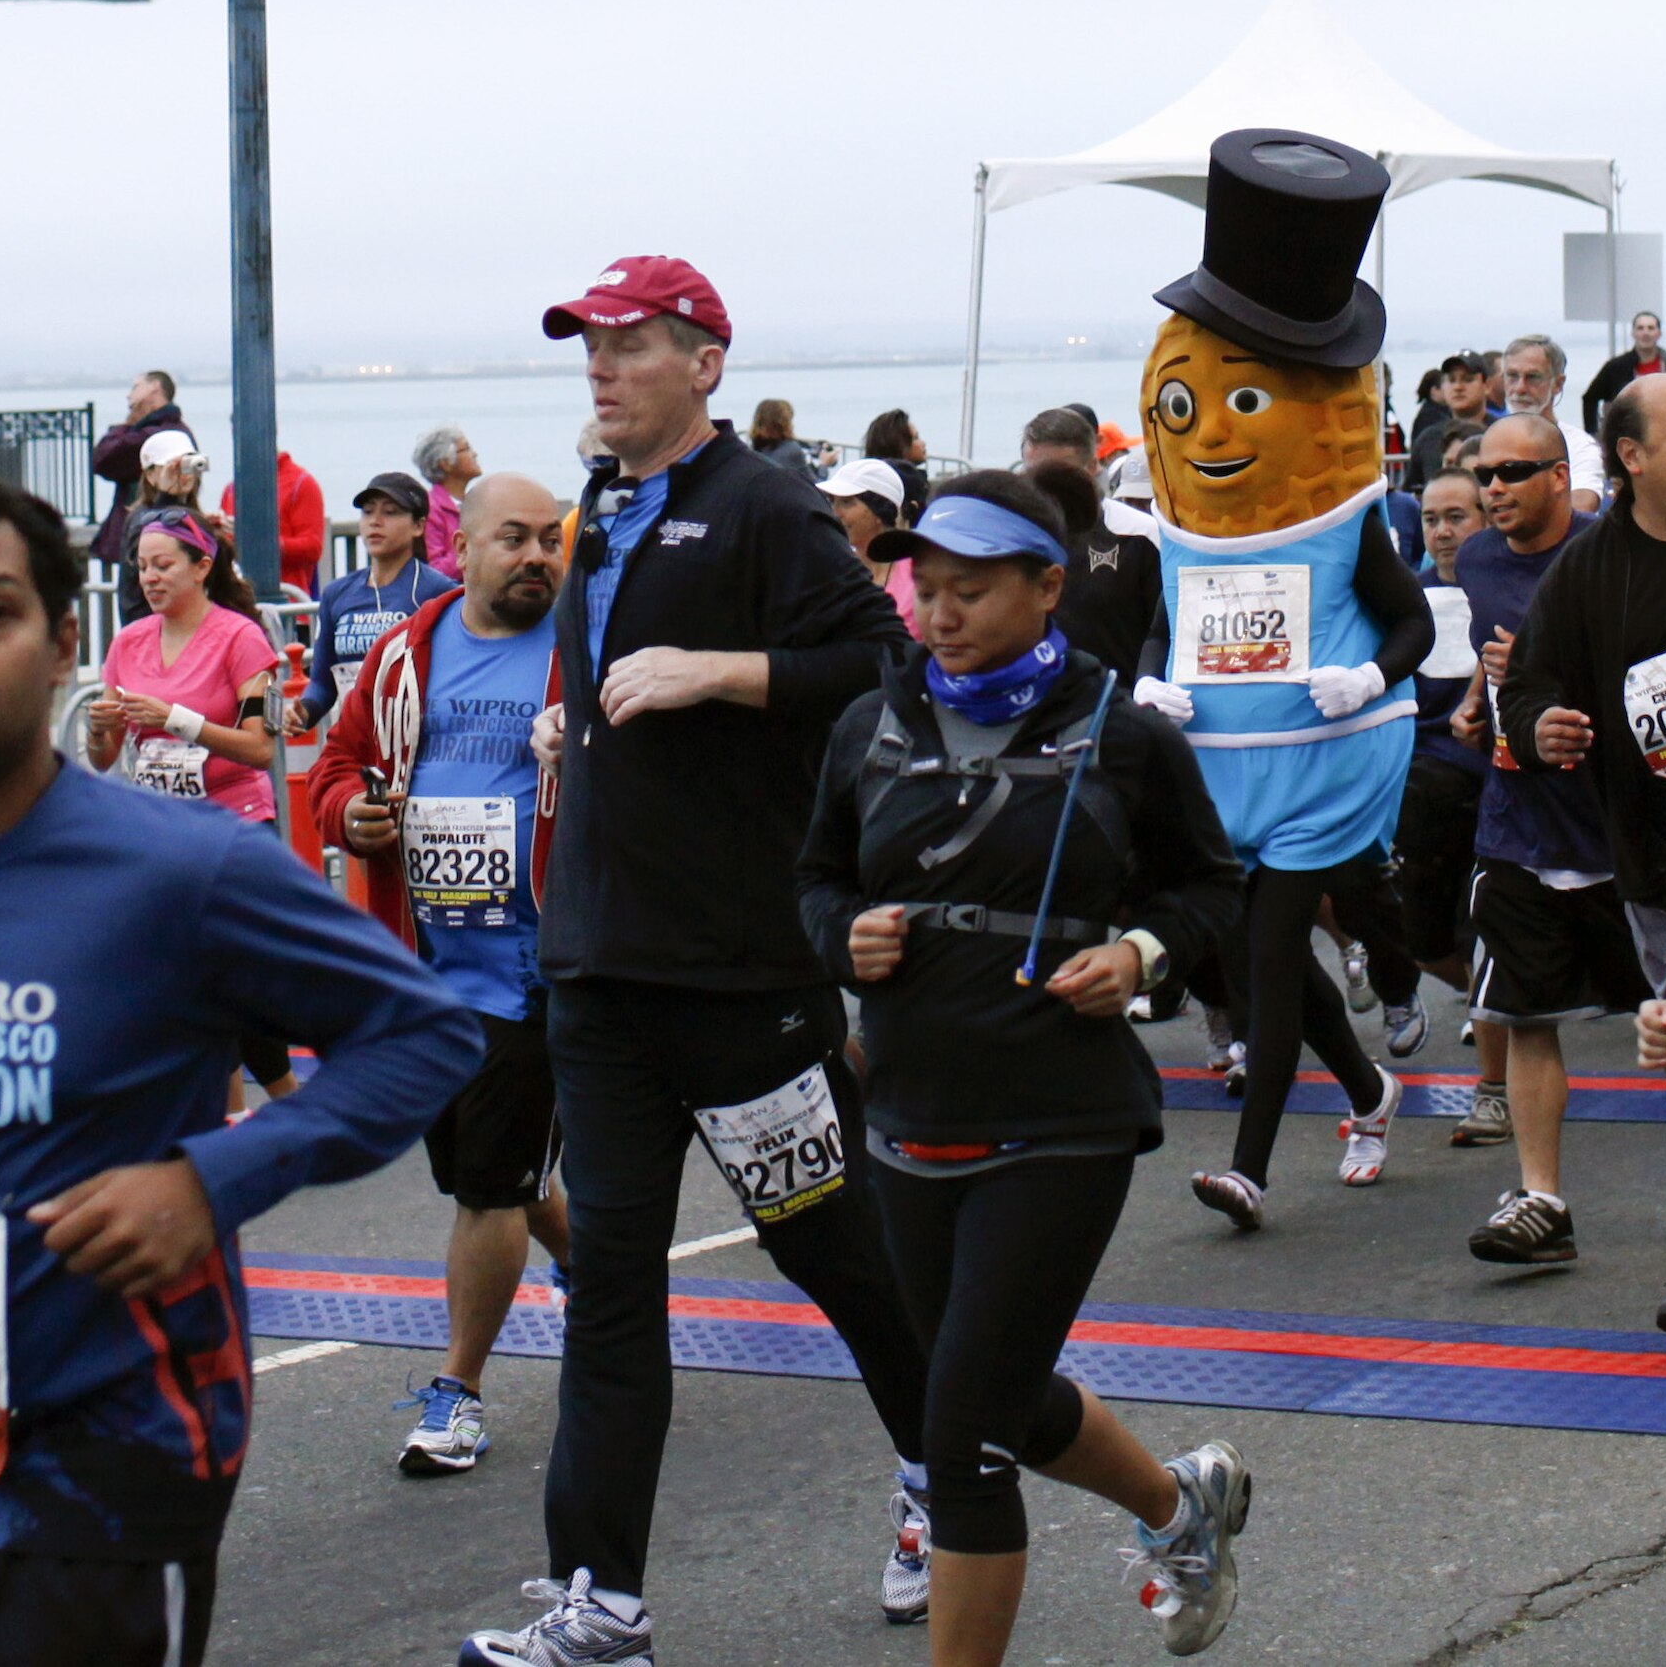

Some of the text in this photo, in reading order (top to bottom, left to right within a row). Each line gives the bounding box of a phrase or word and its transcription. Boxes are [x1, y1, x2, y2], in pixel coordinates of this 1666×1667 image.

[589, 309, 645, 325] NEW YORK
[352, 610, 409, 625] WIPRO
[1200, 609, 1287, 644] 81052
[349, 622, 394, 636] FRANCIS
[335, 635, 377, 656] ARAT
[448, 698, 537, 719] WIPRO
[448, 716, 532, 734] FRANCISCO
[422, 833, 486, 845] PAPALOTE
[408, 847, 510, 886] 82328
[754, 1127, 798, 1155] FELIX
[725, 1120, 845, 1202] 82790
[754, 1205, 781, 1218] HALF
[783, 1175, 845, 1211] MARATHON
